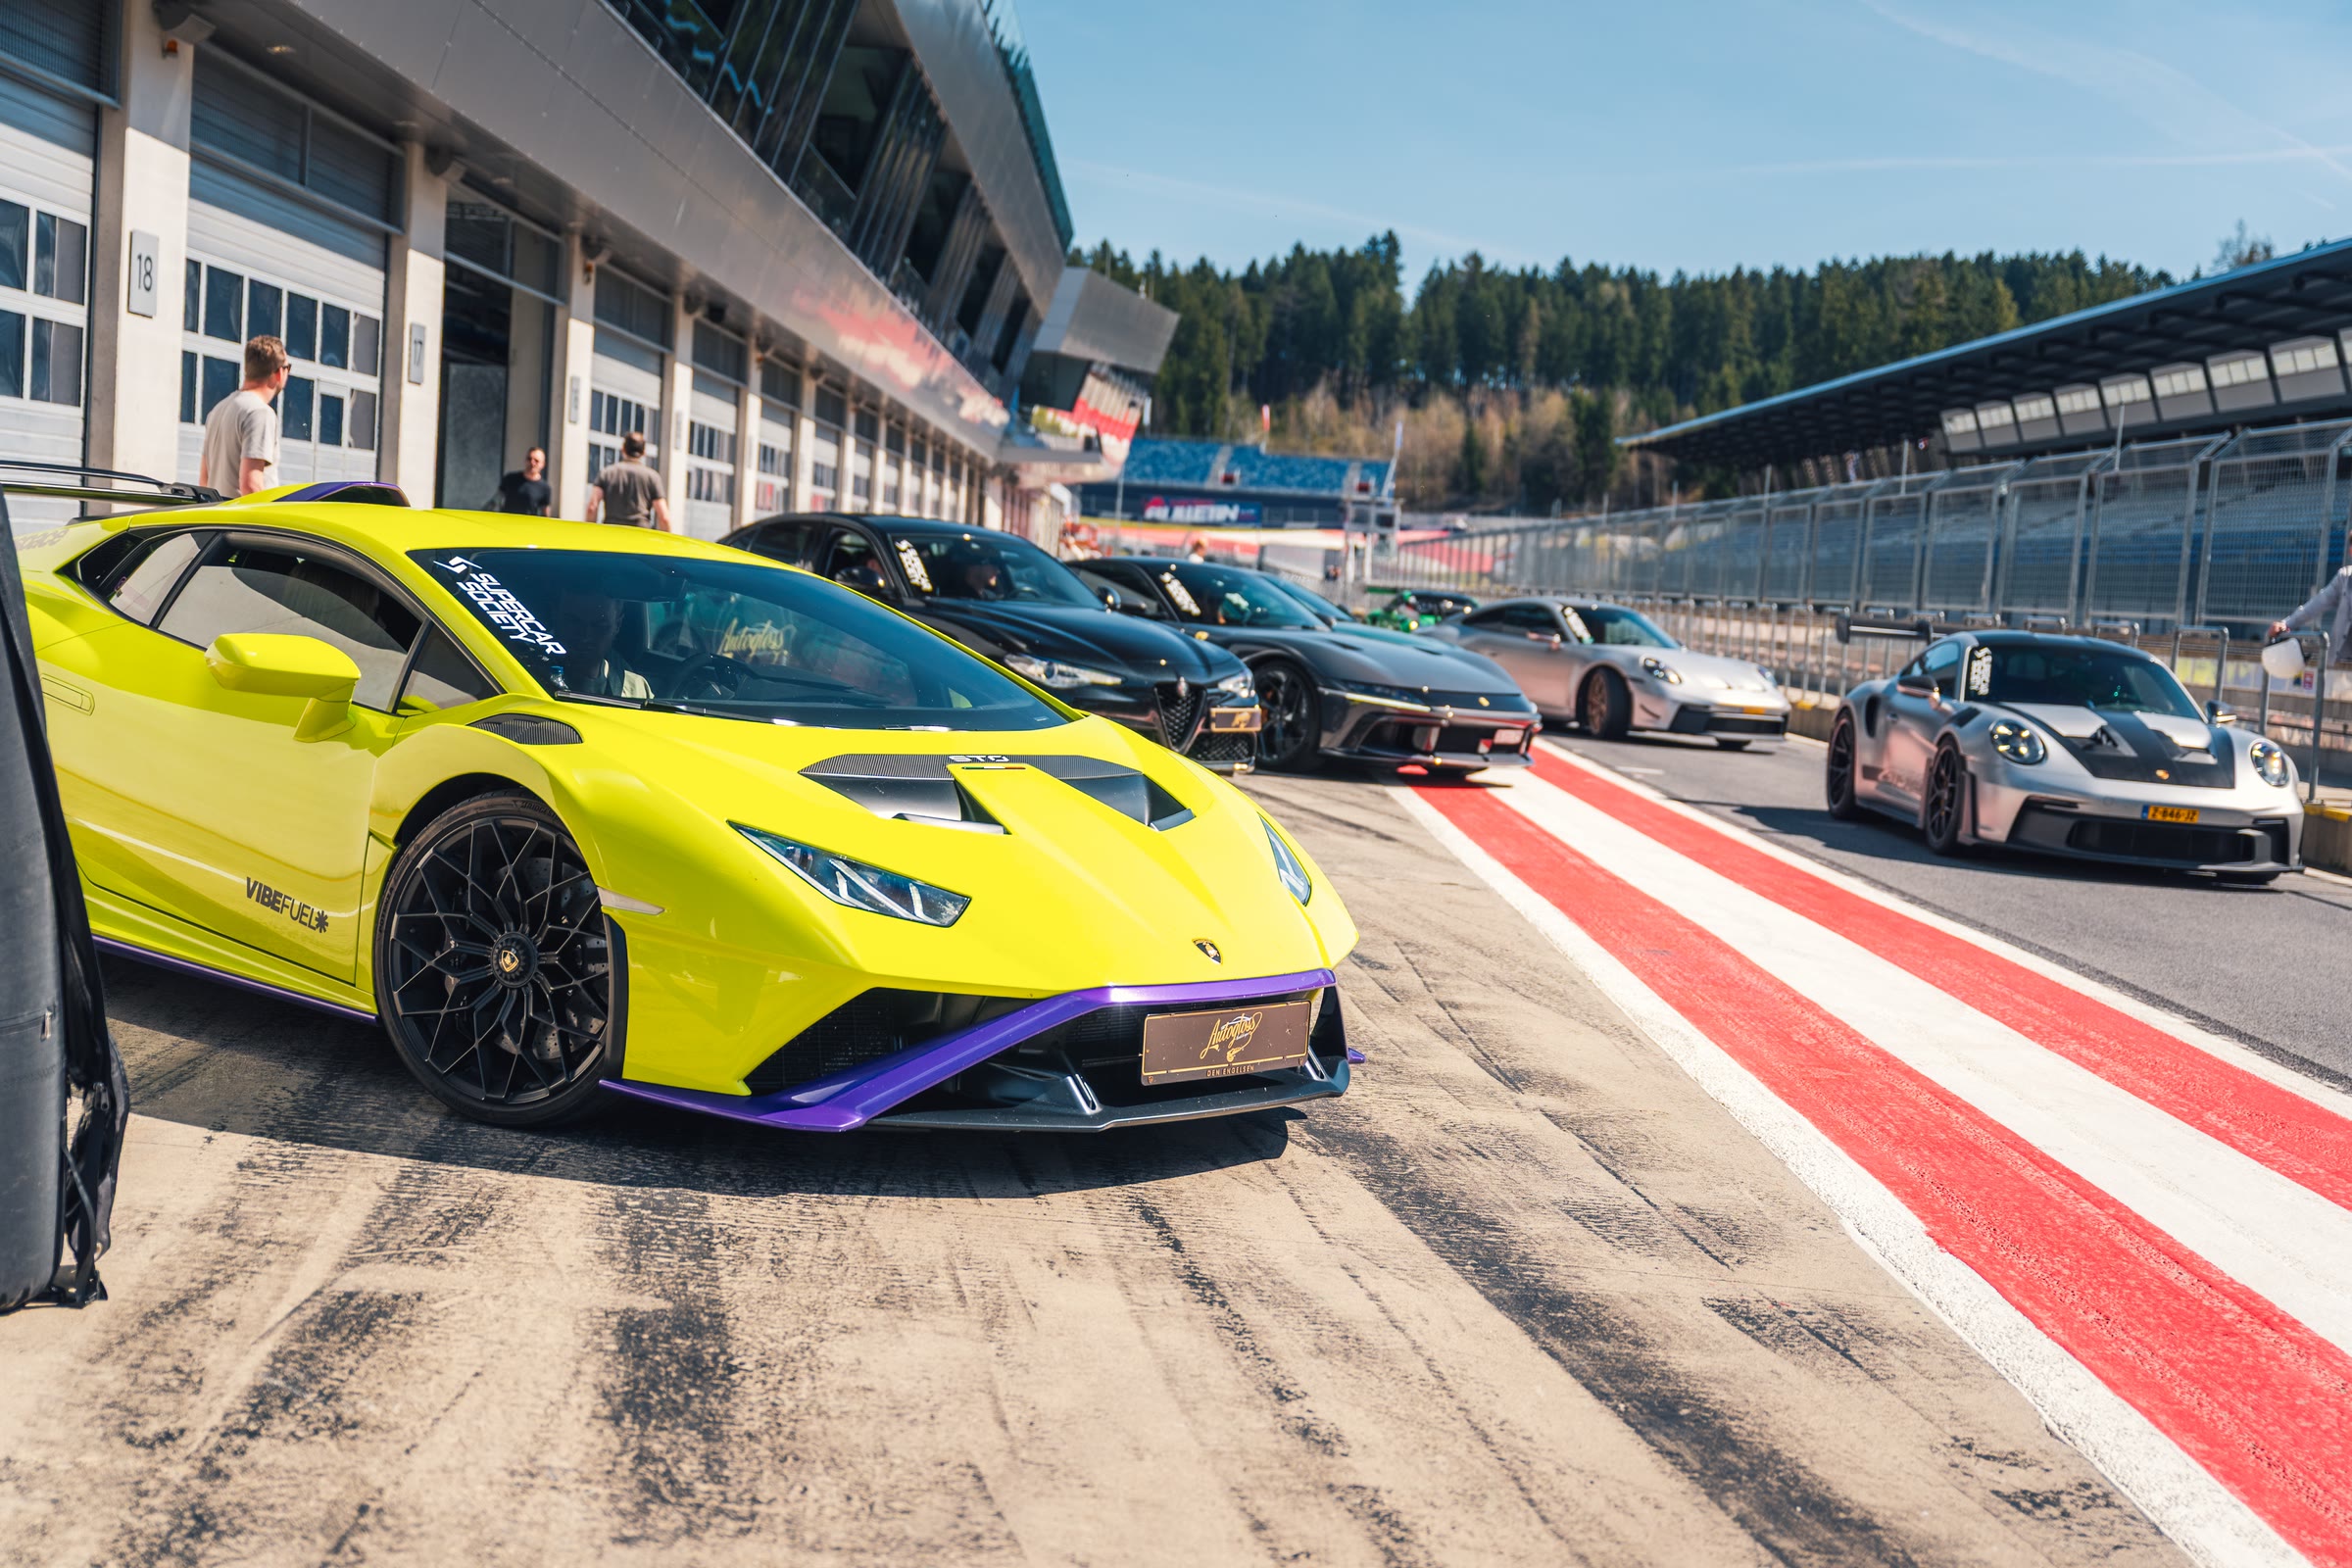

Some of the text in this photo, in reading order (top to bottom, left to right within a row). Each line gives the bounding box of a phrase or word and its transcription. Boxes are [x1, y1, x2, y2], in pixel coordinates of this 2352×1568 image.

[136, 252, 154, 292] 18
[413, 337, 423, 367] 17
[456, 581, 537, 644] SOCIETY
[469, 572, 567, 655] SUPERCAR
[378, 886, 394, 934] POTENZA
[1200, 1011, 1263, 1059] Autogloss
[1222, 1064, 1254, 1075] ENGELSEN
